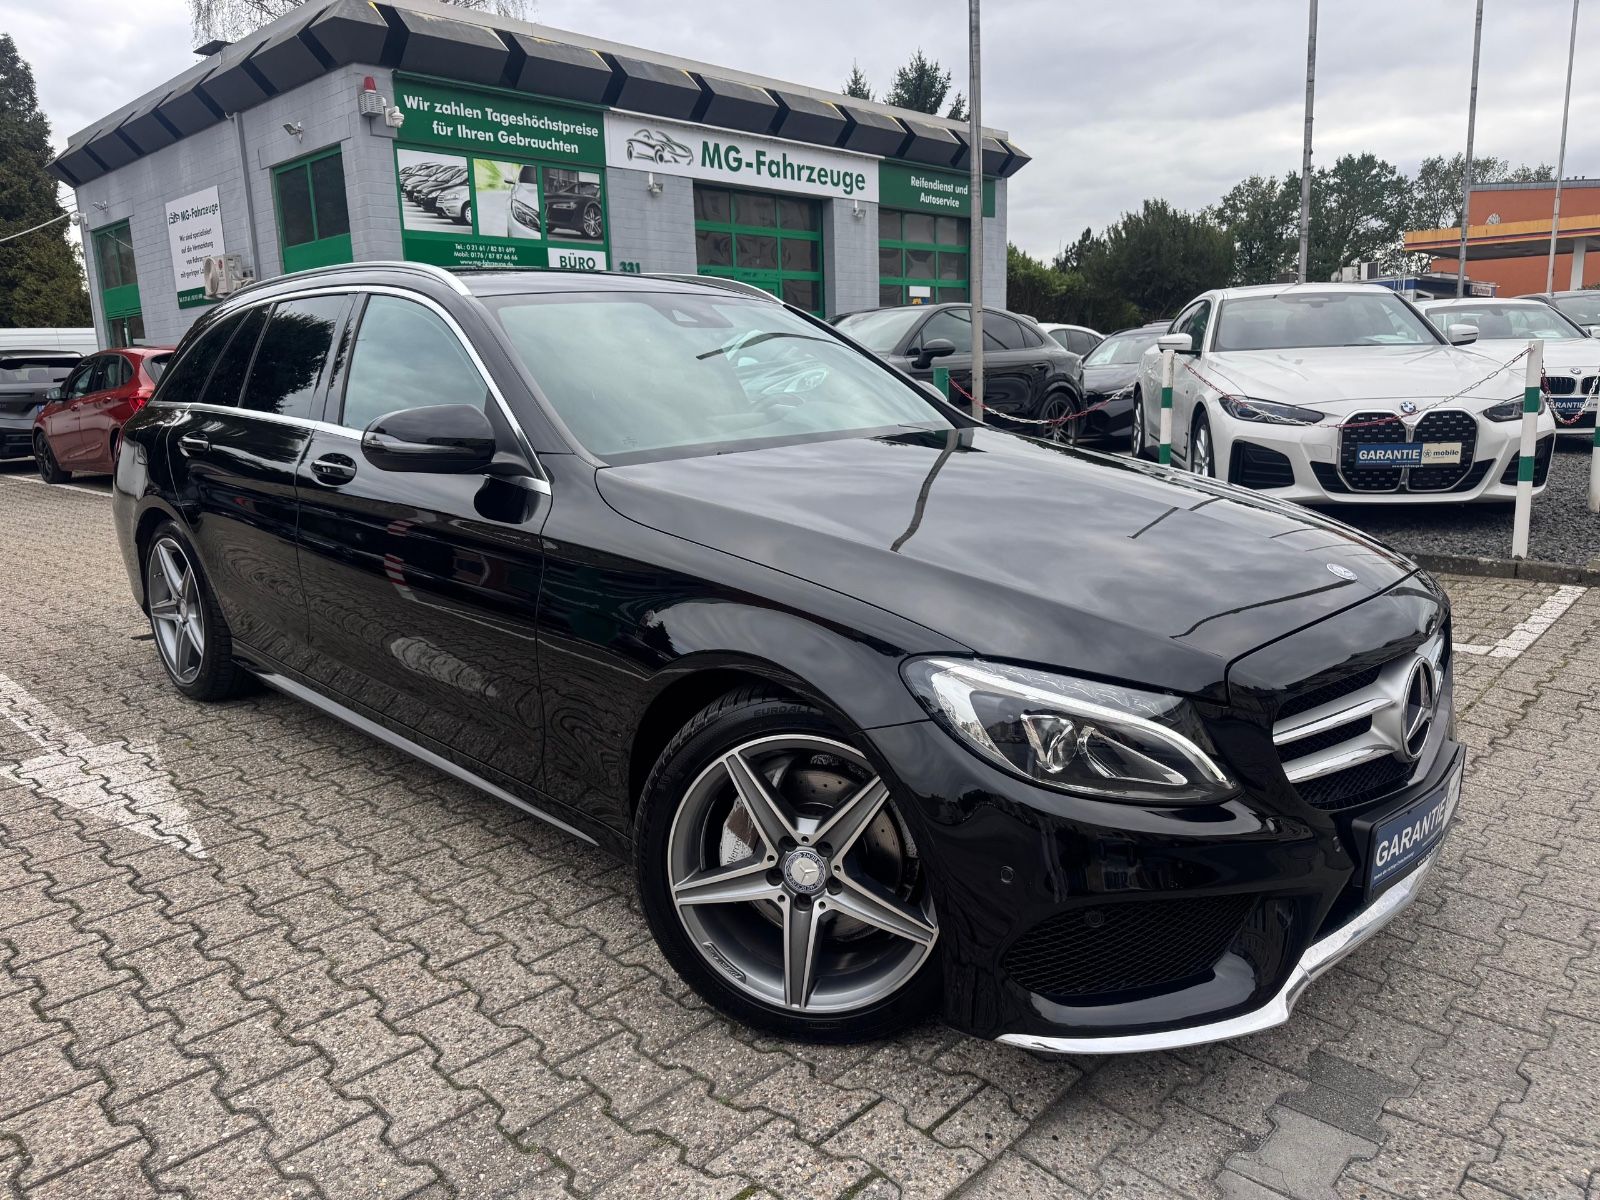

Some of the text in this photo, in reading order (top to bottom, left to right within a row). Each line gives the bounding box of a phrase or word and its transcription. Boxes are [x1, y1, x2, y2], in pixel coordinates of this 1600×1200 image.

[403, 94, 599, 137] Wir zahlen Tageshöchstpreise
[432, 121, 579, 154] für Ihren Gebrauchten
[701, 140, 866, 195] MG-Fahrzeuge
[910, 175, 968, 195] Reifendienst und
[919, 193, 960, 208] Autoservice
[180, 204, 218, 221] MG-Fahrzeuge
[559, 252, 596, 270] BÜRO
[619, 261, 641, 273] 331
[1359, 449, 1421, 460] GARANTIE
[1375, 796, 1447, 867] GARANTIE
